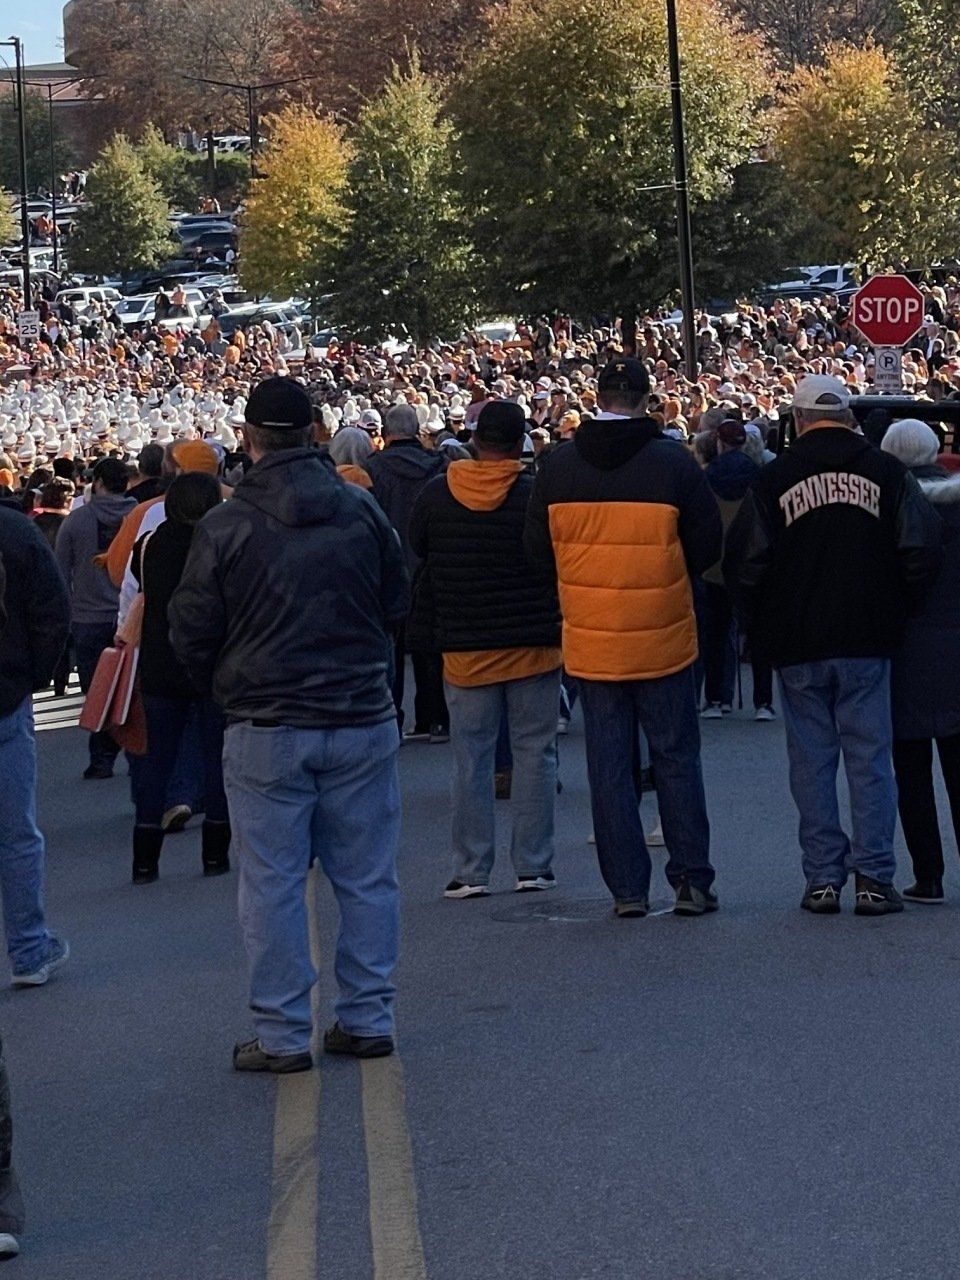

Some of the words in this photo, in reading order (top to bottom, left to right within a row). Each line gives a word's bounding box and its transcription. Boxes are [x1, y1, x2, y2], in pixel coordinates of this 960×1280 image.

[859, 297, 920, 323] STOP
[21, 324, 38, 335] 25
[779, 472, 881, 528] TENNESSEE
